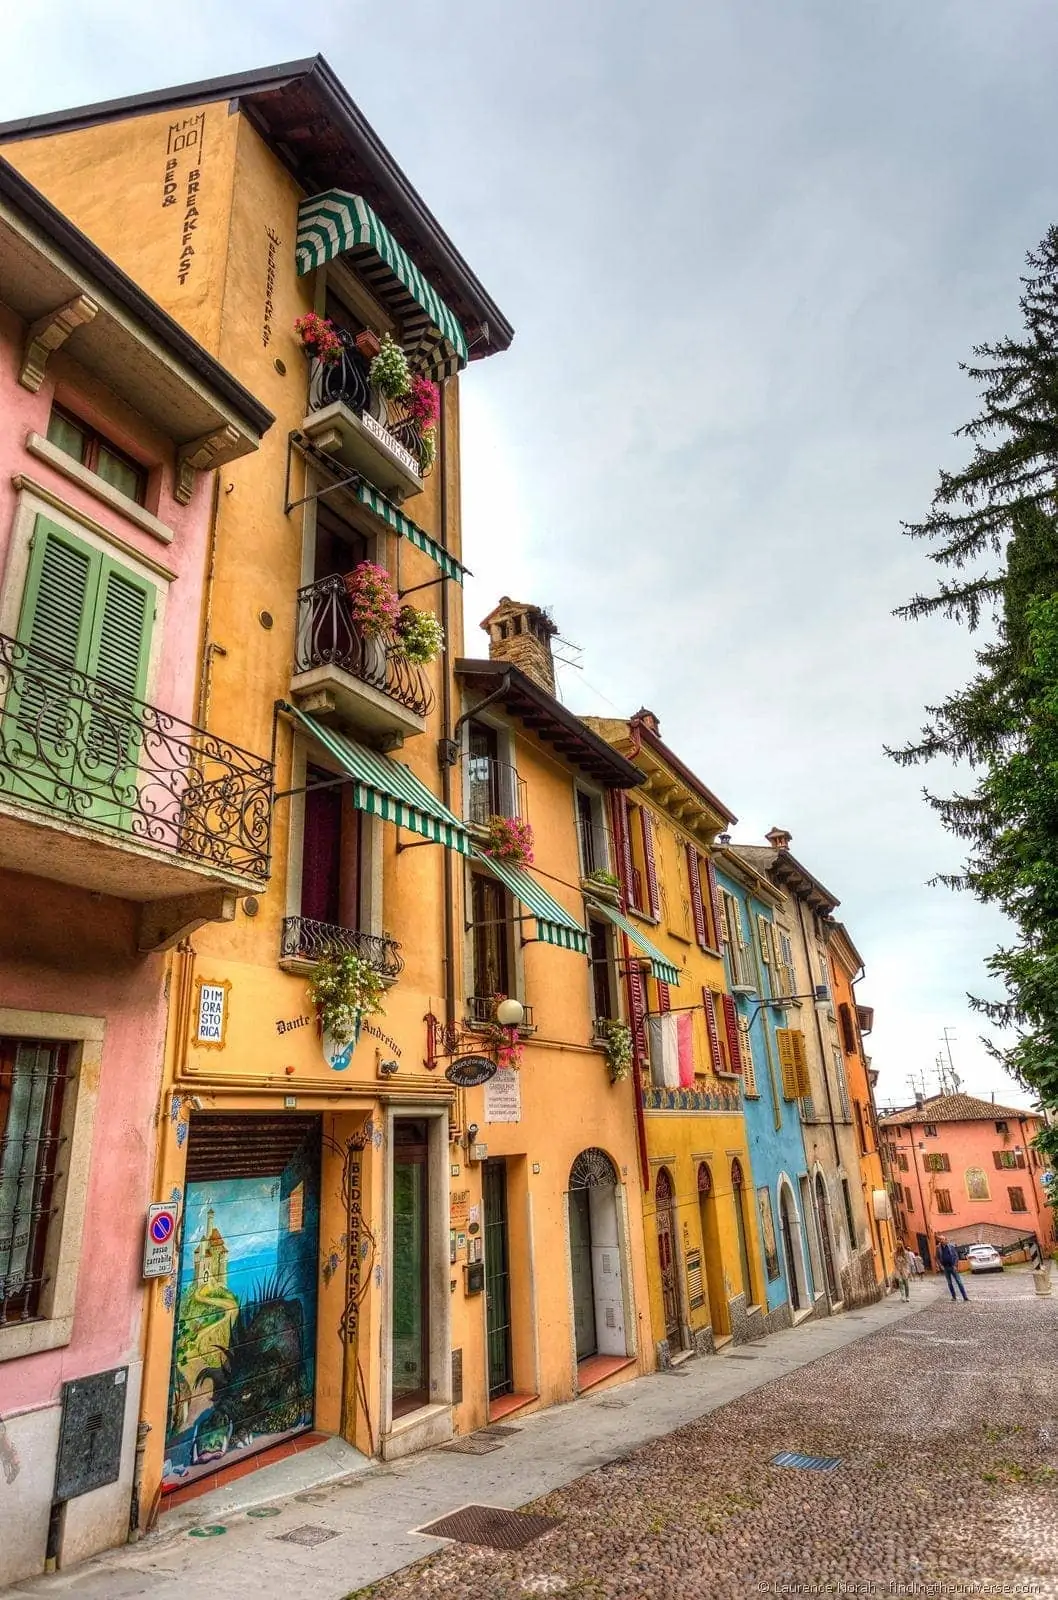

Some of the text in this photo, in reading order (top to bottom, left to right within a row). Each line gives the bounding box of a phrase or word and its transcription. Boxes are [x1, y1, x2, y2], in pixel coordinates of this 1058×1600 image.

[177, 169, 200, 286] BREAKFAST
[202, 989, 223, 1000] DIM
[202, 1001, 222, 1014] ORA
[201, 1014, 221, 1025] STO
[275, 1015, 311, 1035] Dante
[200, 1025, 220, 1038] RICA
[362, 1019, 402, 1058] Andreina
[152, 1246, 168, 1256] passo
[147, 1255, 172, 1265] carrabile
